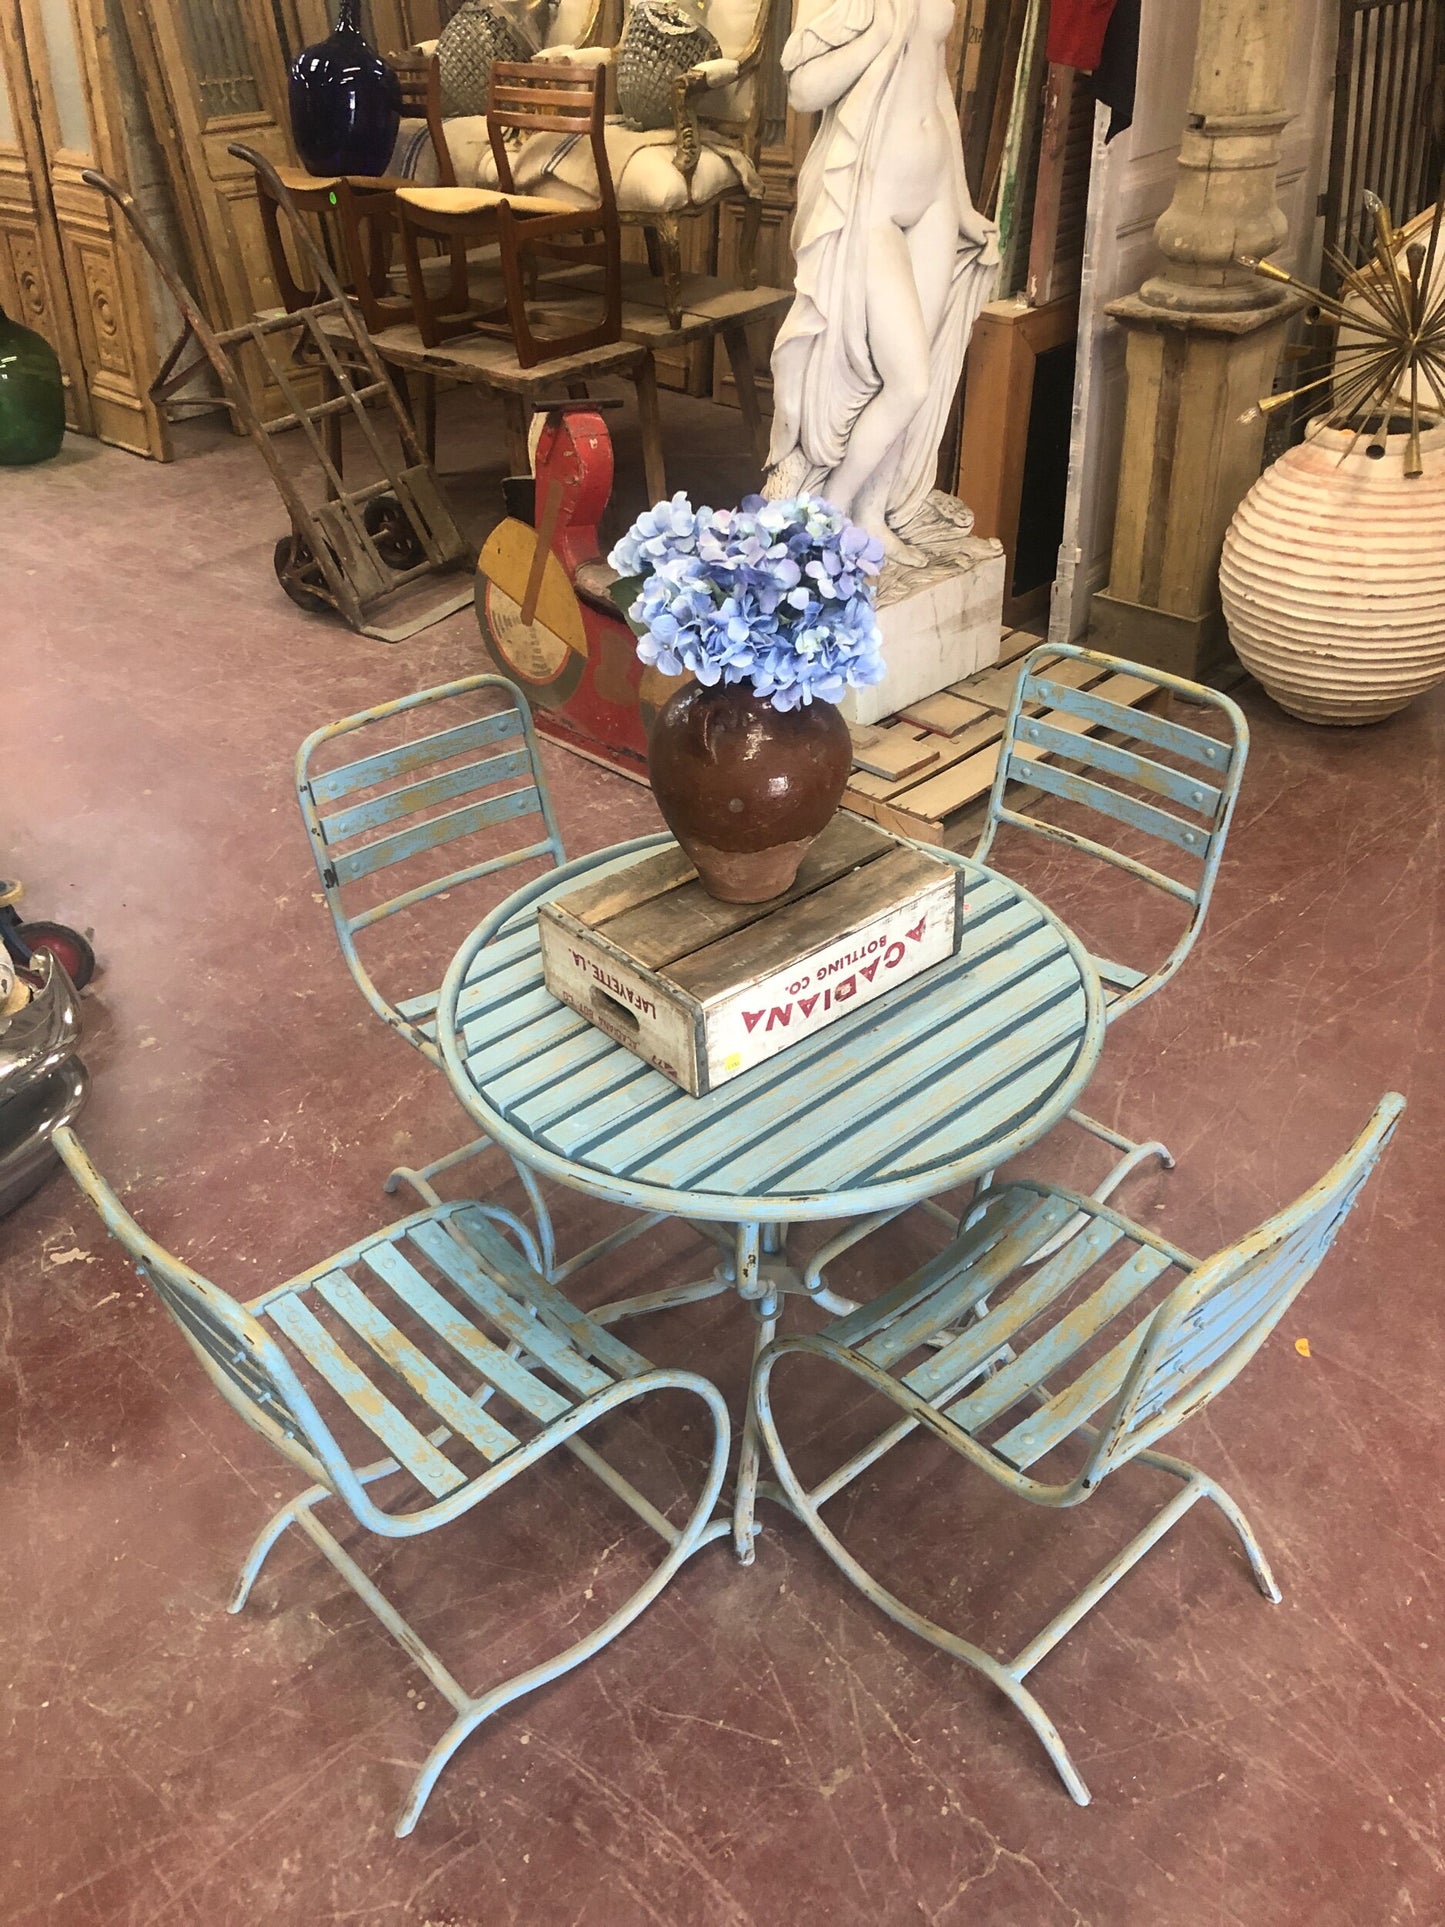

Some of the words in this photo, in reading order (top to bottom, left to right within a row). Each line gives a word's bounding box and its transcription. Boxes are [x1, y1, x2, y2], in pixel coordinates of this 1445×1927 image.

[741, 914, 928, 1034] ACADIANA
[816, 935, 887, 981] BOTTLING
[785, 976, 811, 996] CO.
